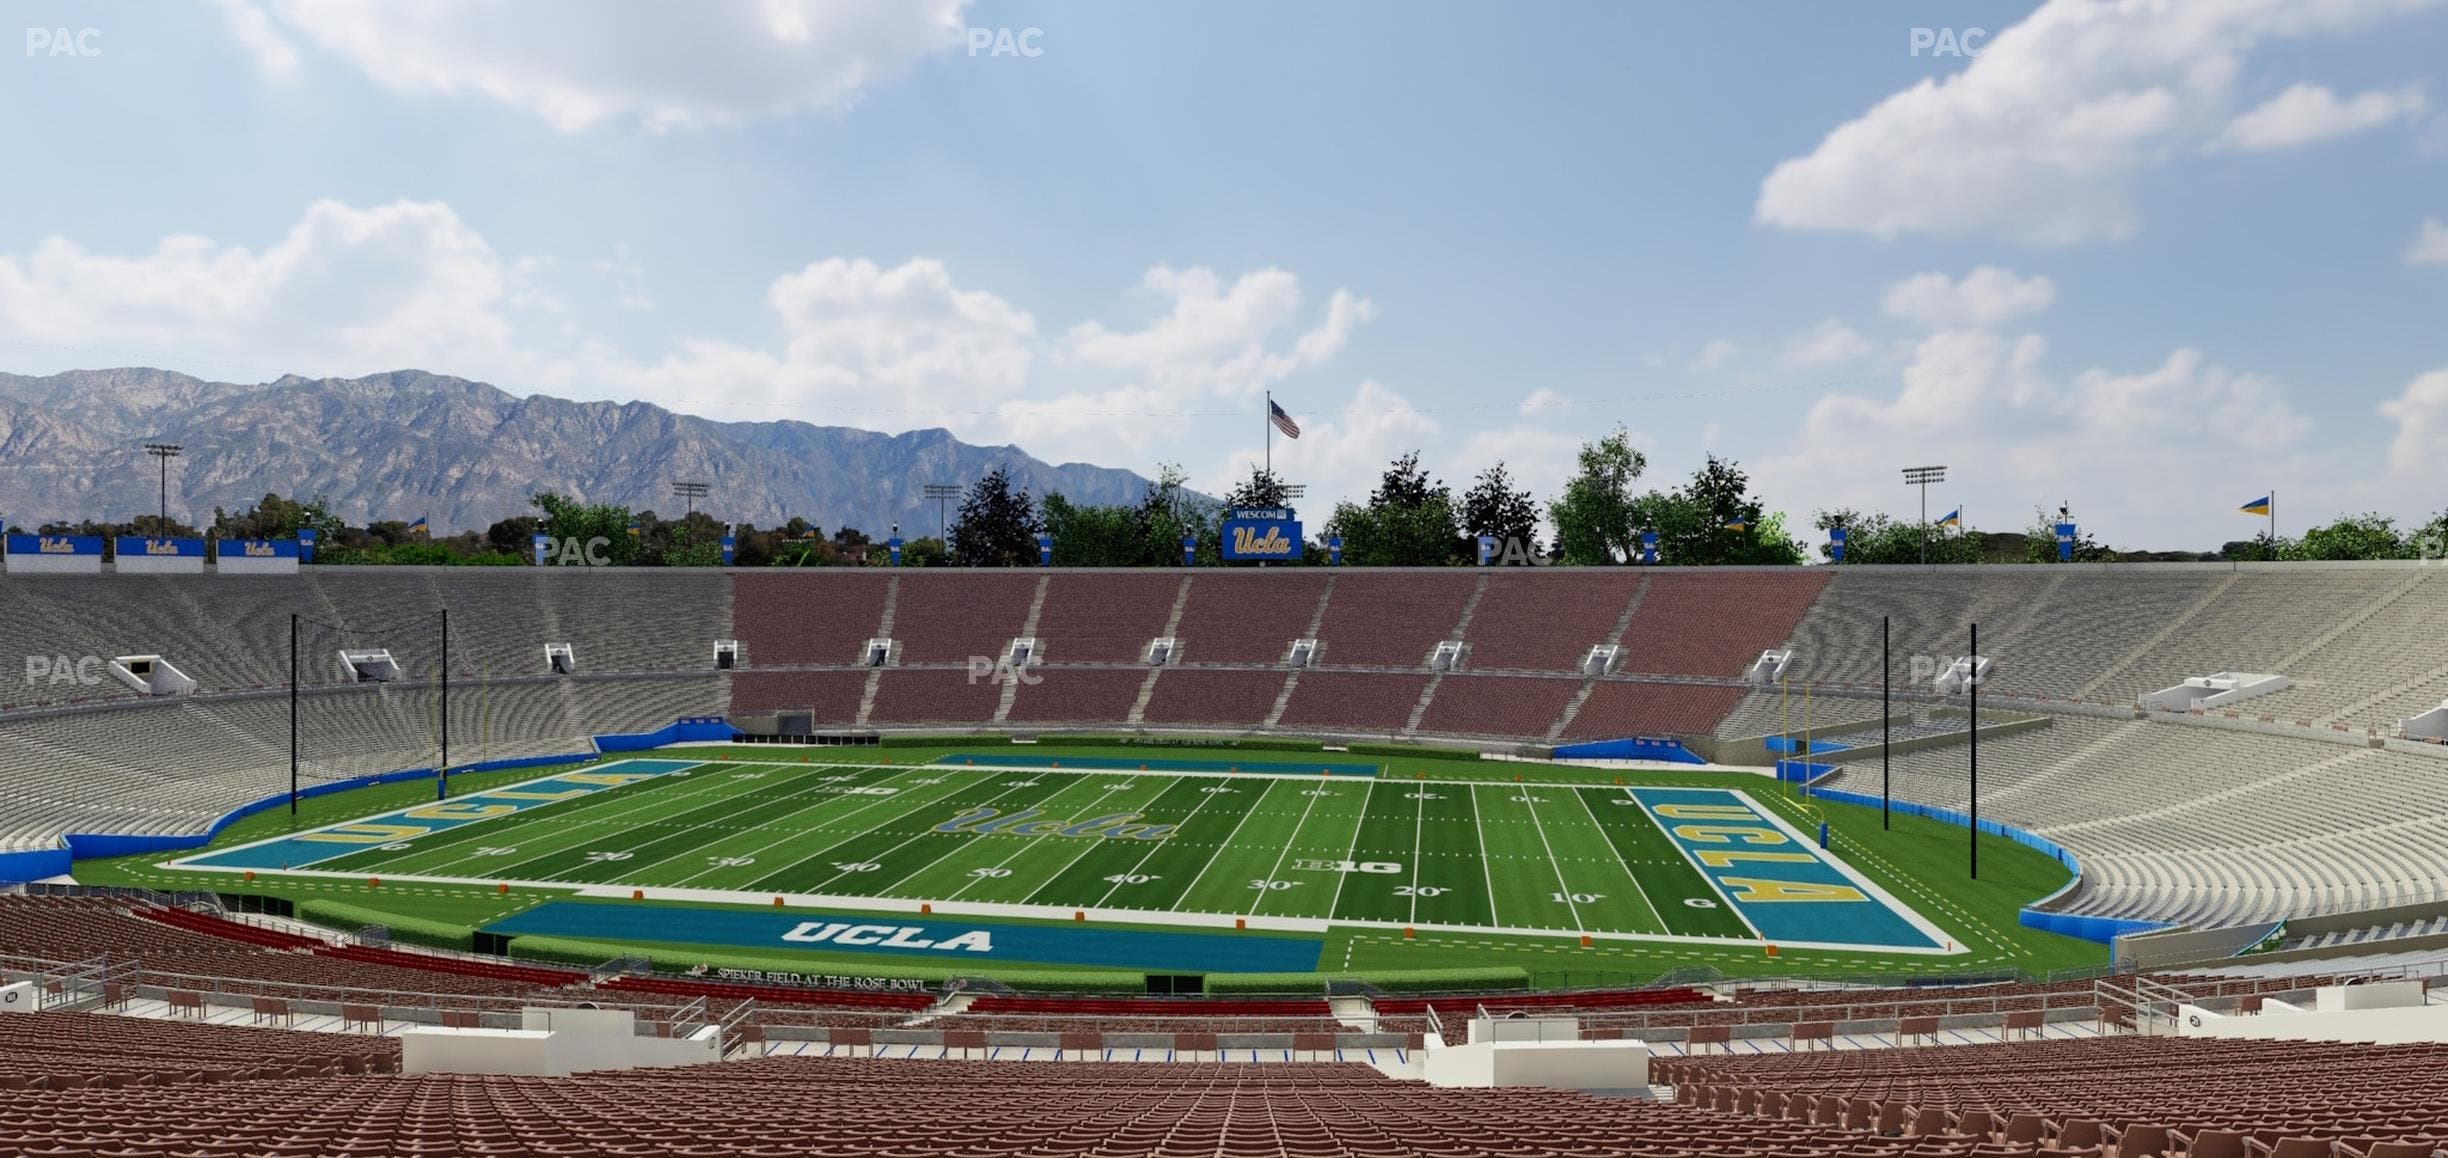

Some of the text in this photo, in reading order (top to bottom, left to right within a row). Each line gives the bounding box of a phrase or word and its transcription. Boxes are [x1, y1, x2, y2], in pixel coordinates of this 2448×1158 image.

[1236, 510, 1276, 519] WESCOM
[1233, 526, 1292, 554] Ucla
[1651, 803, 1872, 903] UCLA
[965, 867, 1013, 879] 50
[1103, 873, 1151, 884] 40
[1246, 879, 1292, 891] 30
[1392, 885, 1441, 897] 20
[1549, 891, 1599, 904] 10
[780, 921, 994, 952] UCLA
[717, 968, 928, 992] SPIEKER FIELD AT THE ROSE BOWL
